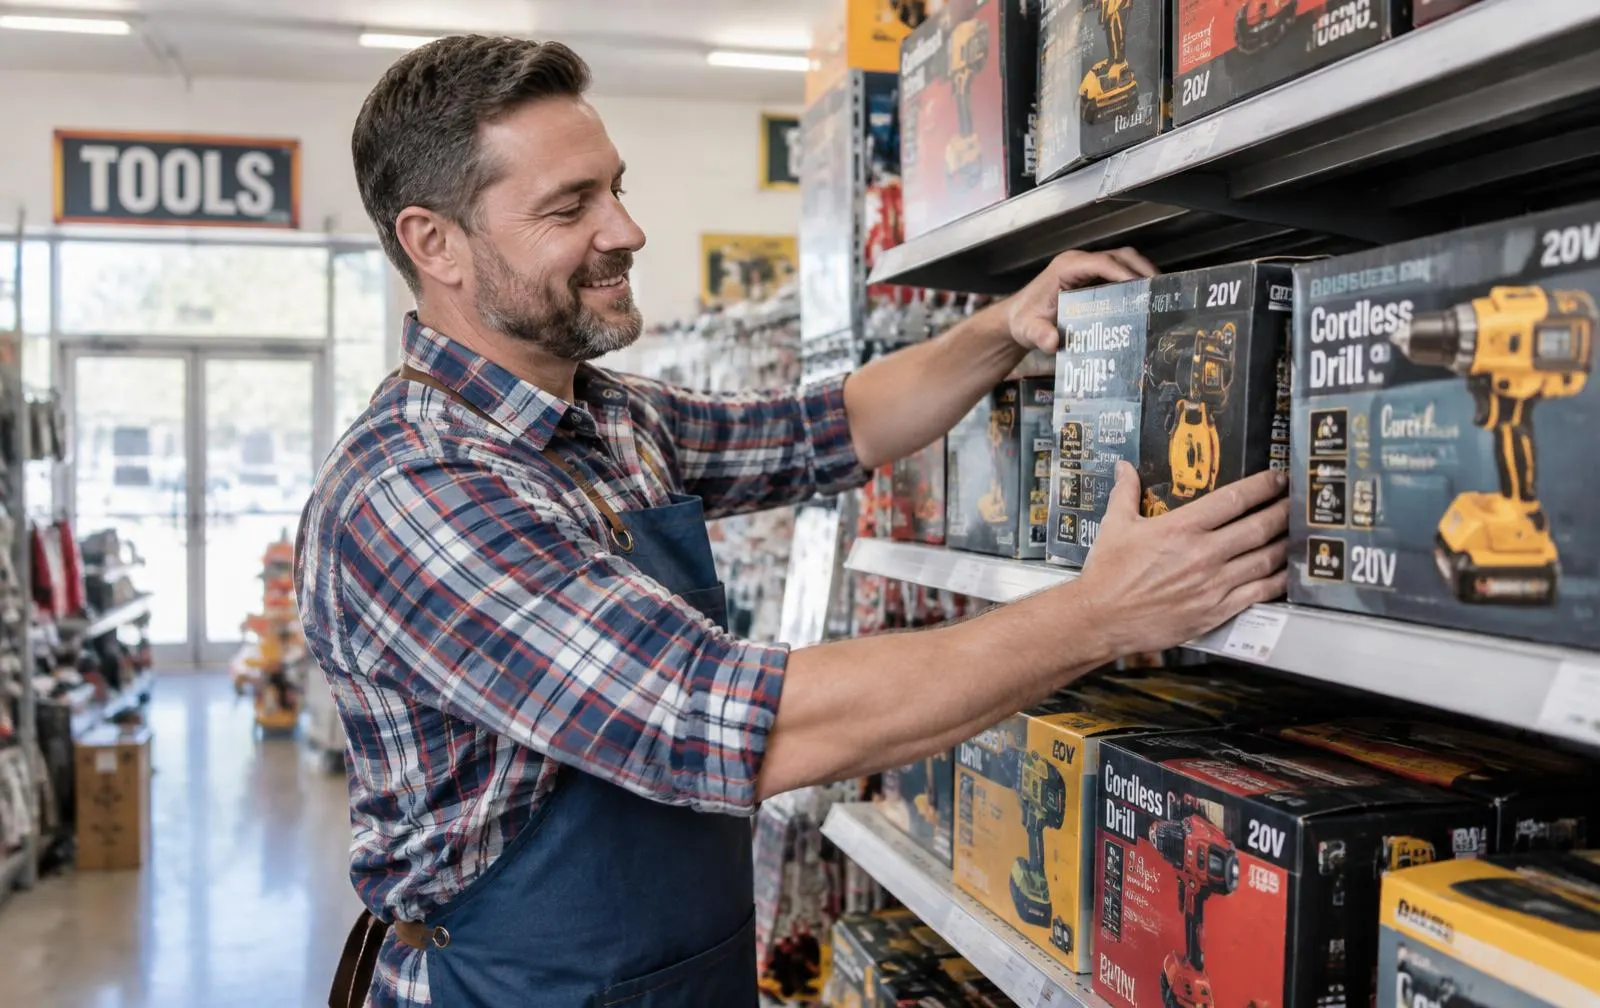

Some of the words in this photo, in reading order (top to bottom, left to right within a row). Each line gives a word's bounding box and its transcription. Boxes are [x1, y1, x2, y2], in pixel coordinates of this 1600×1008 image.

[79, 144, 275, 217] TOOLS
[1541, 222, 1600, 268] 20V
[1206, 280, 1241, 308] 20V
[1310, 300, 1415, 344] Cordless
[1310, 348, 1365, 389] Drill
[1351, 545, 1397, 587] 20V
[1104, 761, 1163, 818] Cordless
[1106, 798, 1136, 840] Drill
[1247, 818, 1286, 860] 20V
